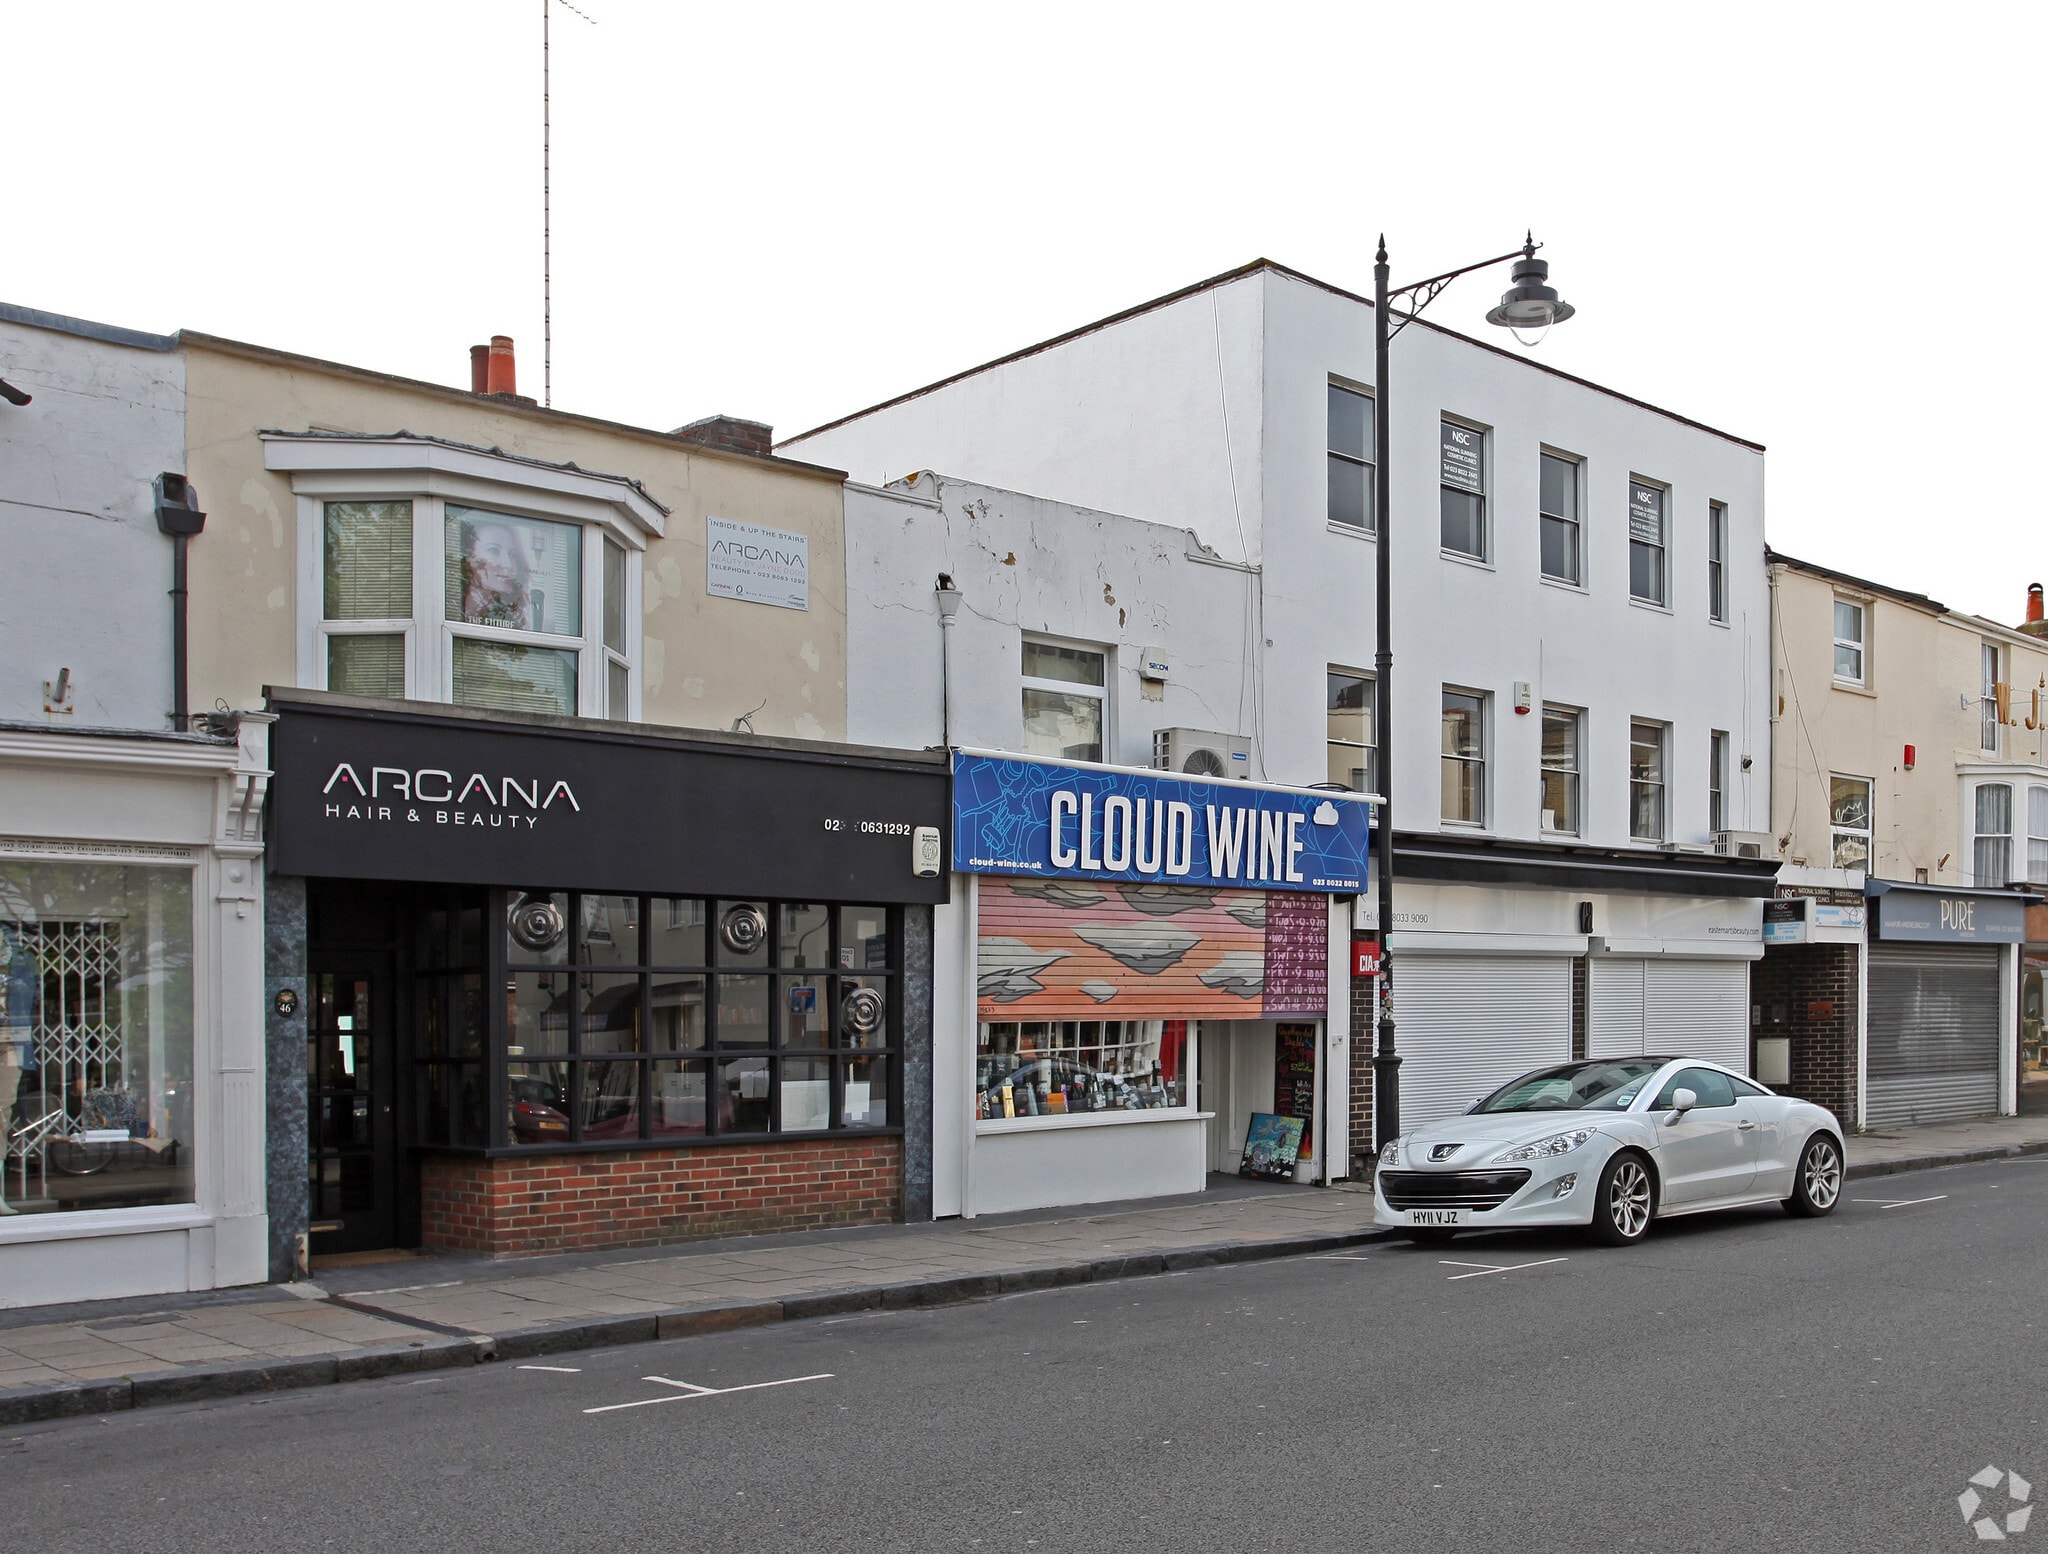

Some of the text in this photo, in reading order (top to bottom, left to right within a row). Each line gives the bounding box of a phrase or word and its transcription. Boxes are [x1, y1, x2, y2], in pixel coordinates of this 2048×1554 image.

[1452, 430, 1470, 446] NSC
[1637, 491, 1652, 504] NSC
[710, 520, 737, 530] INSIDE
[778, 534, 805, 543] STAIRS
[712, 540, 804, 568] ARCANA
[710, 555, 742, 565] BEAUTY
[758, 563, 781, 572] JAYNE
[784, 568, 806, 577] DODD
[711, 564, 751, 575] TELEPHONE
[468, 615, 482, 624] THE
[1148, 662, 1168, 672] SECOM
[322, 763, 580, 812] ARCANA
[325, 804, 537, 829] HAIR & BEAUTY
[1050, 789, 1305, 883] CLOUD WINE
[969, 857, 1042, 869] cloud-wine.co.uk
[1781, 888, 1795, 899] NSC
[1363, 911, 1375, 921] Tel.
[1411, 914, 1428, 923] 9090
[1940, 899, 1975, 930] PURE
[280, 1004, 290, 1012] 46
[1413, 1212, 1433, 1224] HY11
